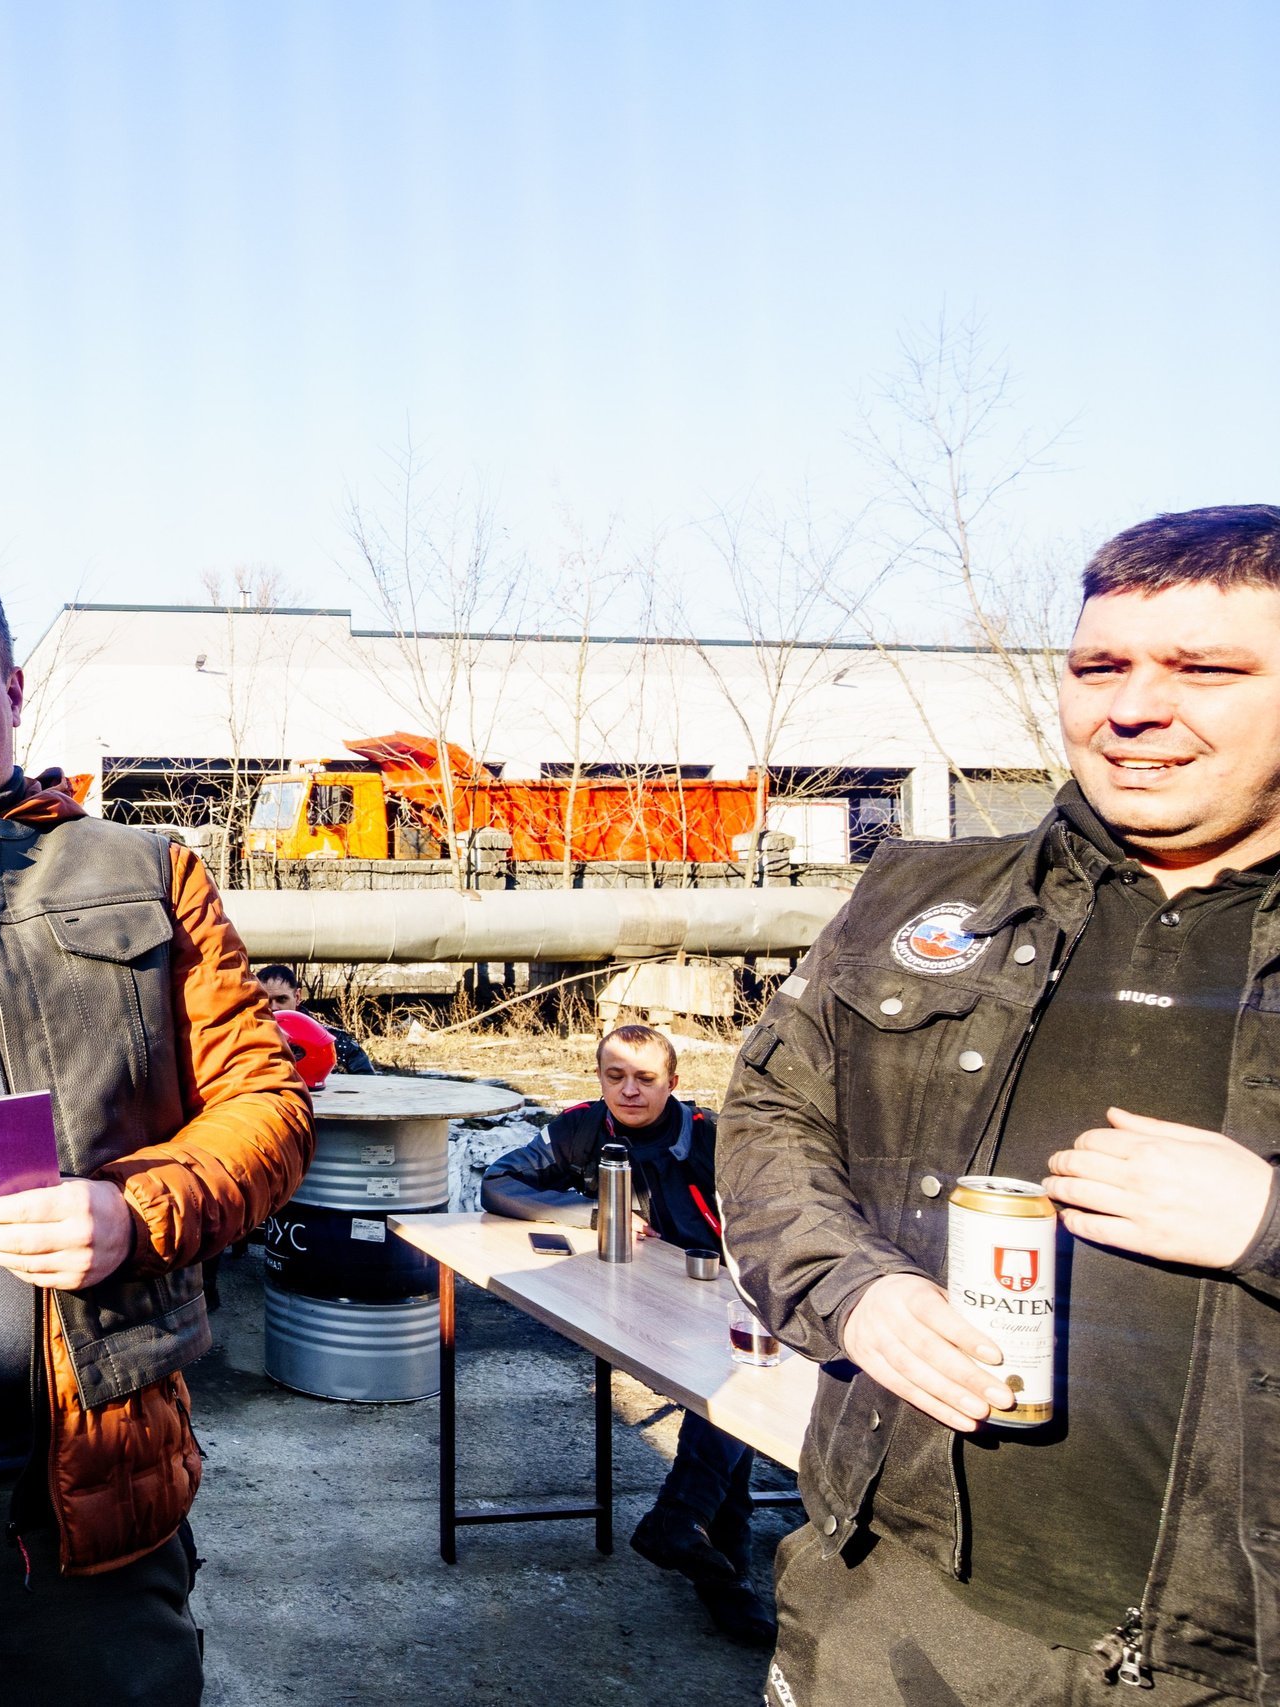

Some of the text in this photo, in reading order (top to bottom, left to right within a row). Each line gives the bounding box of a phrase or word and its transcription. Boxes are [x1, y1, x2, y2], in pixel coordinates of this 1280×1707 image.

[1118, 990, 1173, 1008] HUGO
[264, 1216, 308, 1251] РУС
[963, 1288, 1054, 1315] SPATEN
[989, 1316, 1043, 1333] Original
